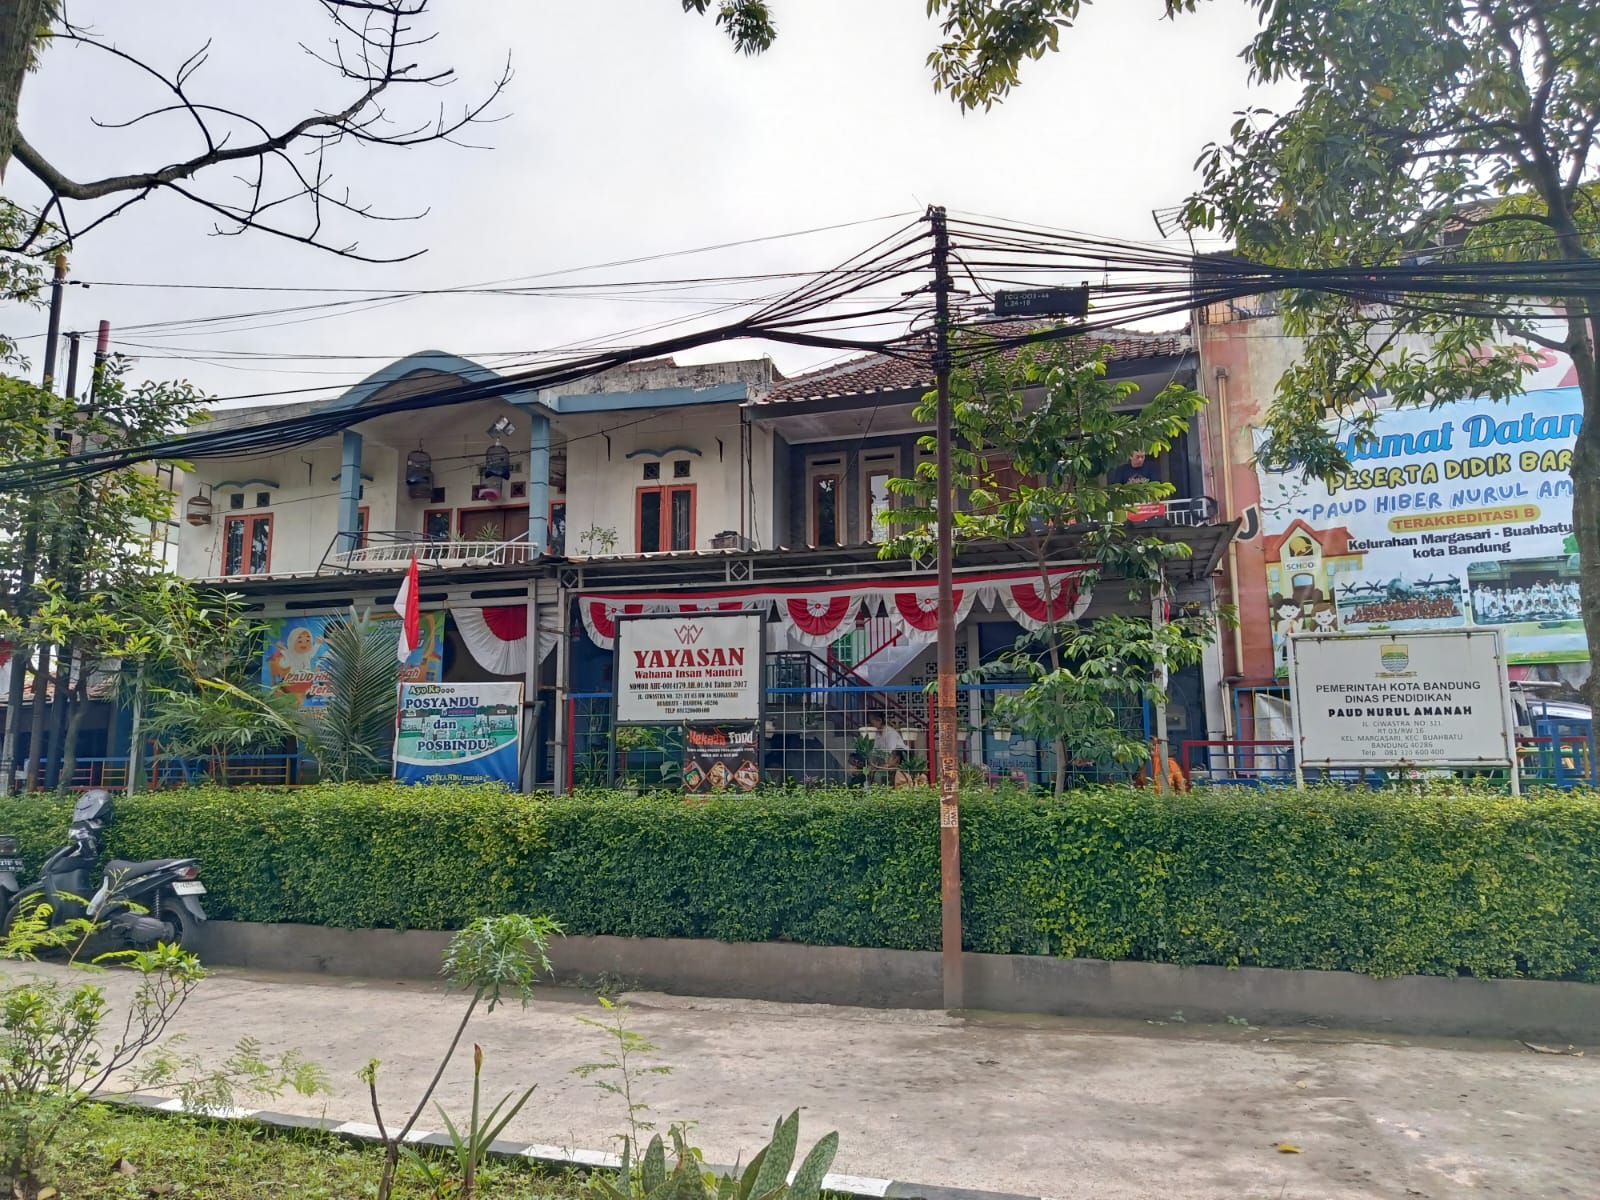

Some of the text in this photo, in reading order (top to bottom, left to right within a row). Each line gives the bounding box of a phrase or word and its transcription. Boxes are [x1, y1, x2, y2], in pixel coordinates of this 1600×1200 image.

[1310, 412, 1584, 463] elamat Datan
[1326, 448, 1573, 496] PESERTA DIDIK BAR
[1312, 498, 1367, 520] PAUD
[1375, 492, 1442, 513] HIBER
[1452, 482, 1528, 507] NURUL
[1393, 507, 1535, 530] TERAKREDITASI B
[1348, 536, 1418, 551] Kelurahan
[1421, 528, 1491, 545] Margasari
[1502, 522, 1573, 538] Buahbatu
[1412, 541, 1512, 559] kota Bandung
[633, 647, 745, 669] YAYASAN
[634, 668, 743, 679] Wahana Insan Mandiri
[408, 685, 427, 695] Ayo
[733, 680, 748, 688] 2017
[1315, 681, 1481, 693] PEMERINTAH KOTA BANDUNG
[405, 696, 479, 709] POSYANDU
[1345, 693, 1452, 703] DINAS PENDIDIKAN
[1328, 706, 1472, 718] PAUD NURUL AMANAH
[433, 719, 457, 729] dan
[417, 740, 487, 751] POSBINDU
